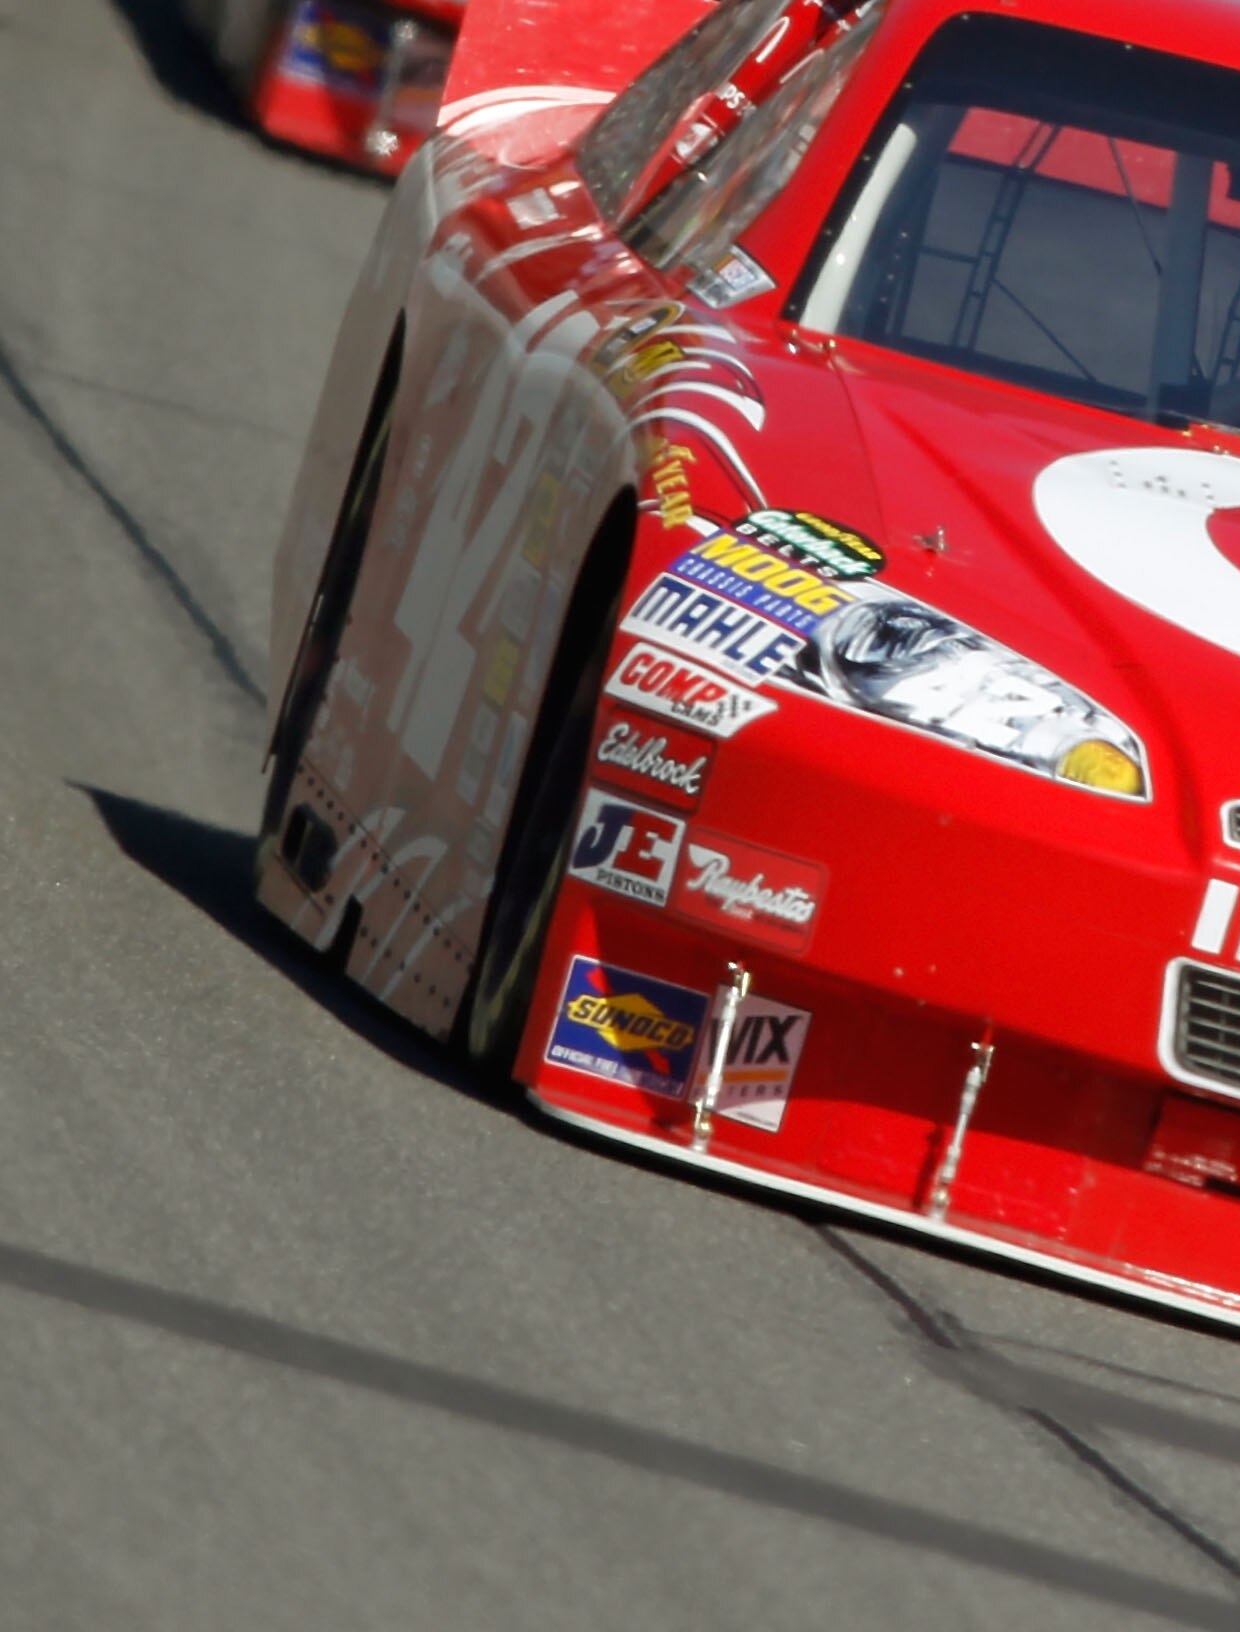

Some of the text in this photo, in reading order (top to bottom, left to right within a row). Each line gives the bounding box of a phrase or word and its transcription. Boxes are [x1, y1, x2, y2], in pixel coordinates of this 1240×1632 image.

[690, 533, 856, 616] MOOG
[735, 523, 838, 578] BELTS
[633, 575, 799, 676] MAHLE
[676, 558, 811, 627] CHASSIS PARTS
[620, 652, 728, 708] COMP
[671, 699, 723, 727] CAMS
[597, 723, 706, 794] Edelbrock
[573, 804, 677, 882] JE
[597, 869, 666, 904] PISTONS
[686, 843, 815, 923] Raybestos
[574, 998, 693, 1047] SUNOCO
